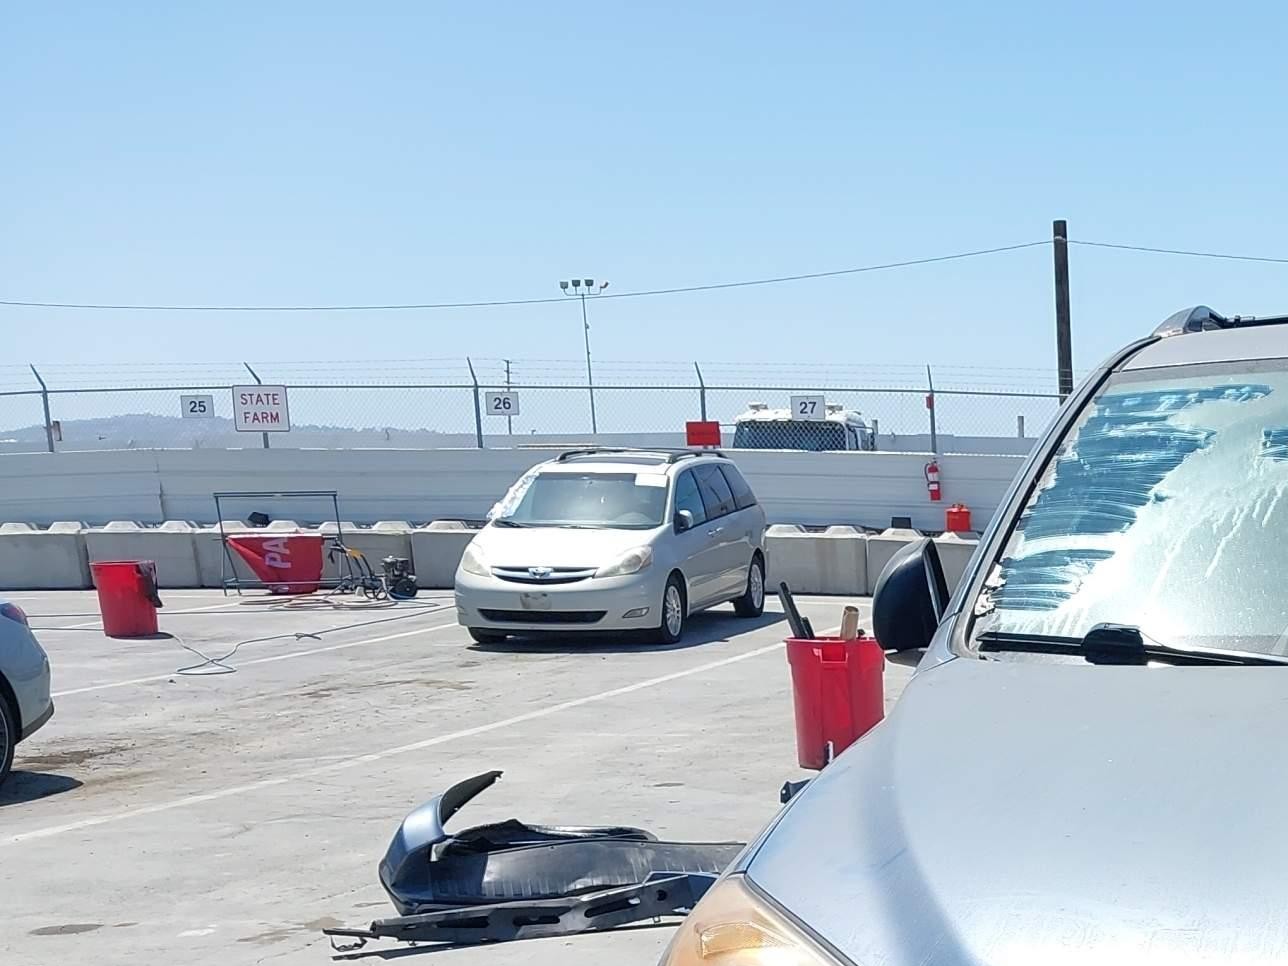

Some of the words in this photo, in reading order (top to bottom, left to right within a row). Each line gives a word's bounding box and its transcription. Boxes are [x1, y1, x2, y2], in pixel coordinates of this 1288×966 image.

[240, 393, 280, 405] STATE
[493, 397, 512, 410] 26
[189, 401, 207, 413] 25
[799, 401, 817, 415] 27
[243, 412, 280, 424] FARM
